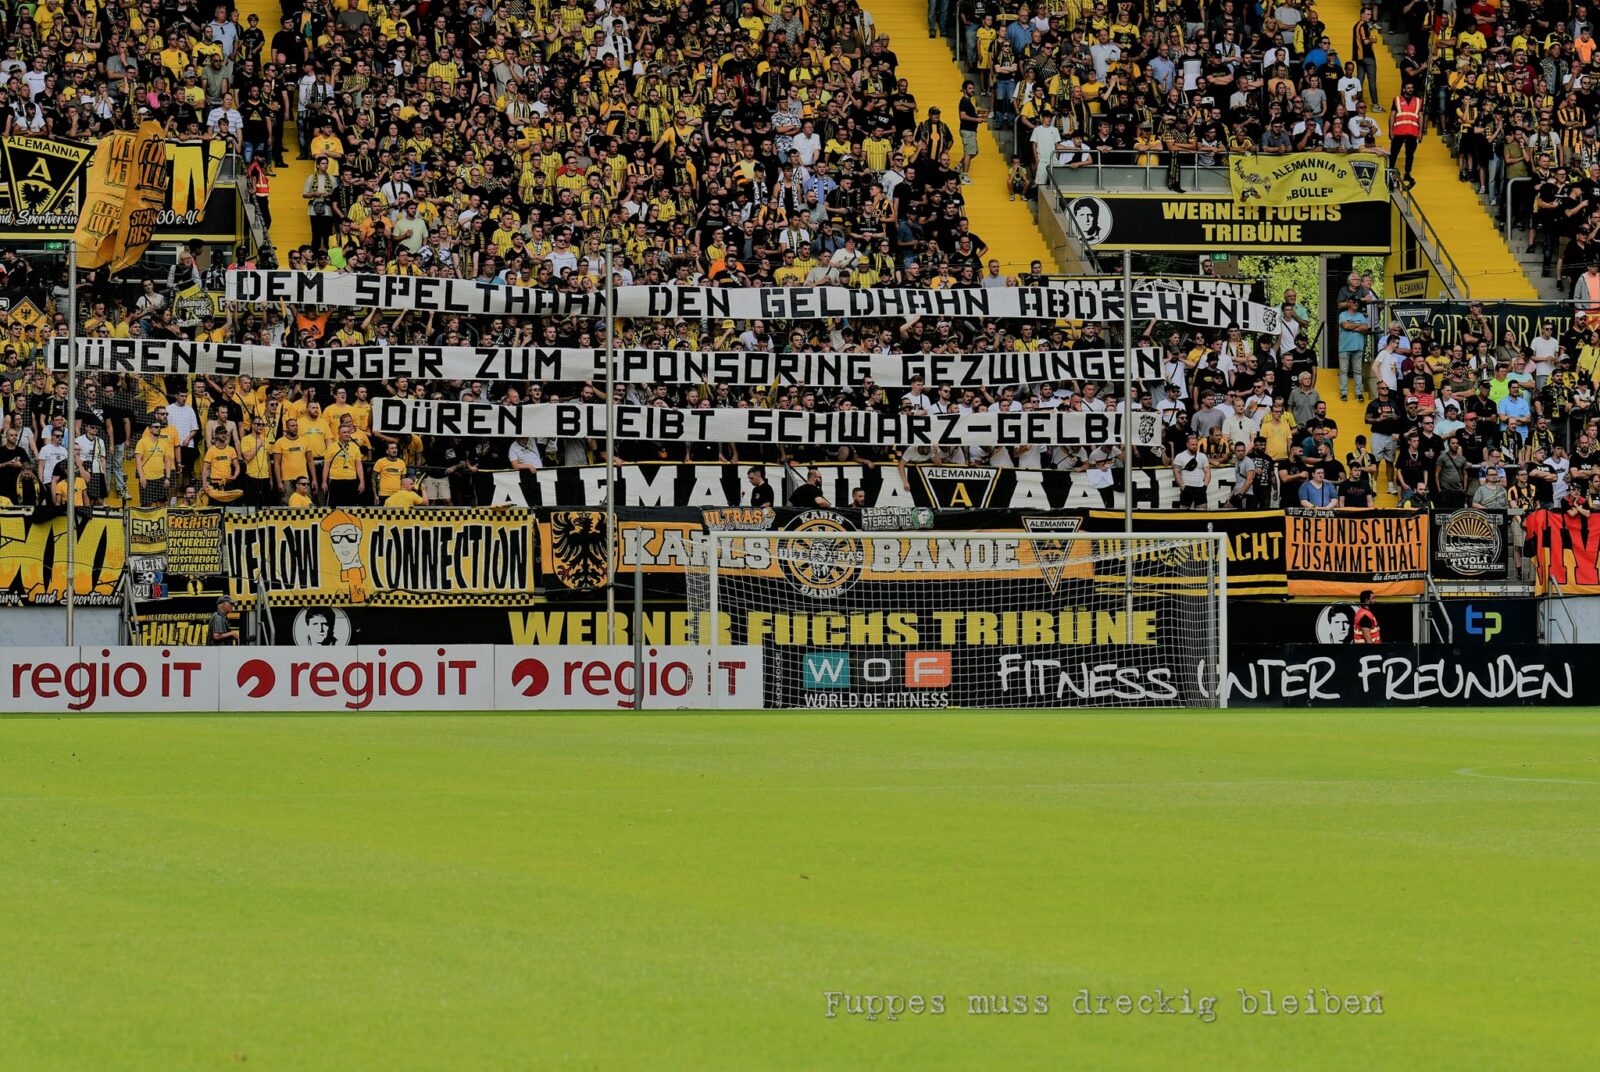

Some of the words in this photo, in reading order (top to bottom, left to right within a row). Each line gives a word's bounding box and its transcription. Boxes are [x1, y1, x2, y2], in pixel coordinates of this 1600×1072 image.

[8, 136, 80, 160] ALEMANNIA
[27, 157, 52, 181] A
[1272, 158, 1347, 180] ALEMANNIA'S
[1301, 172, 1317, 182] AU
[16, 209, 78, 226] Sportverein
[1162, 201, 1259, 221] WERNER
[1266, 203, 1342, 221] FUCHS
[1201, 222, 1302, 242] TRIBÜNE
[237, 271, 323, 303] DEM
[649, 286, 730, 317] DEN
[760, 288, 989, 317] GELDHAHN
[1018, 287, 1250, 328] ABDREHEN!
[54, 338, 241, 375] DÜREN'S
[274, 347, 443, 380] BÜRGER
[475, 348, 562, 380] ZUM
[593, 349, 871, 386] SPONSORING
[902, 348, 1161, 385] GEZWUNGEN
[381, 401, 523, 436] DÜREN
[556, 404, 715, 440] BLEIBT
[747, 409, 1122, 445] SCHWARZ-GELB!
[927, 469, 991, 479] ALEMANNIA
[950, 482, 973, 507] A
[168, 514, 219, 529] FREIHEIT
[703, 509, 762, 525] ULTRAS
[800, 510, 845, 525] KARLS
[1030, 520, 1075, 528] ALEMANNIA
[1293, 516, 1420, 545] FREUNDSCHAFT
[168, 538, 219, 547] SICHERHEIT
[168, 547, 178, 555] ZU
[135, 558, 163, 571] NEIN
[370, 525, 528, 590] CONNECTION
[871, 537, 1021, 573] BANDE
[1291, 543, 1422, 572] ZUSAMMENHALT
[1450, 555, 1488, 567] TIVOLI
[168, 564, 178, 572] ZU
[181, 564, 219, 572] VERLIEREN
[36, 590, 57, 604] und
[134, 584, 150, 597] ZU
[801, 584, 847, 598] BANDE
[508, 611, 733, 646] WERNER
[747, 611, 920, 646] FUCHS
[933, 606, 1158, 646] TRIBÜNE
[12, 649, 148, 711] regio
[161, 649, 202, 697] iT
[290, 648, 423, 710] regio
[437, 648, 476, 696] iT
[564, 648, 694, 709] regio
[998, 653, 1178, 699] FITNESS
[1358, 654, 1574, 700] FREUNDEN
[804, 693, 858, 708] WORLD
[863, 693, 883, 708] OF
[887, 692, 949, 708] FITNESS
